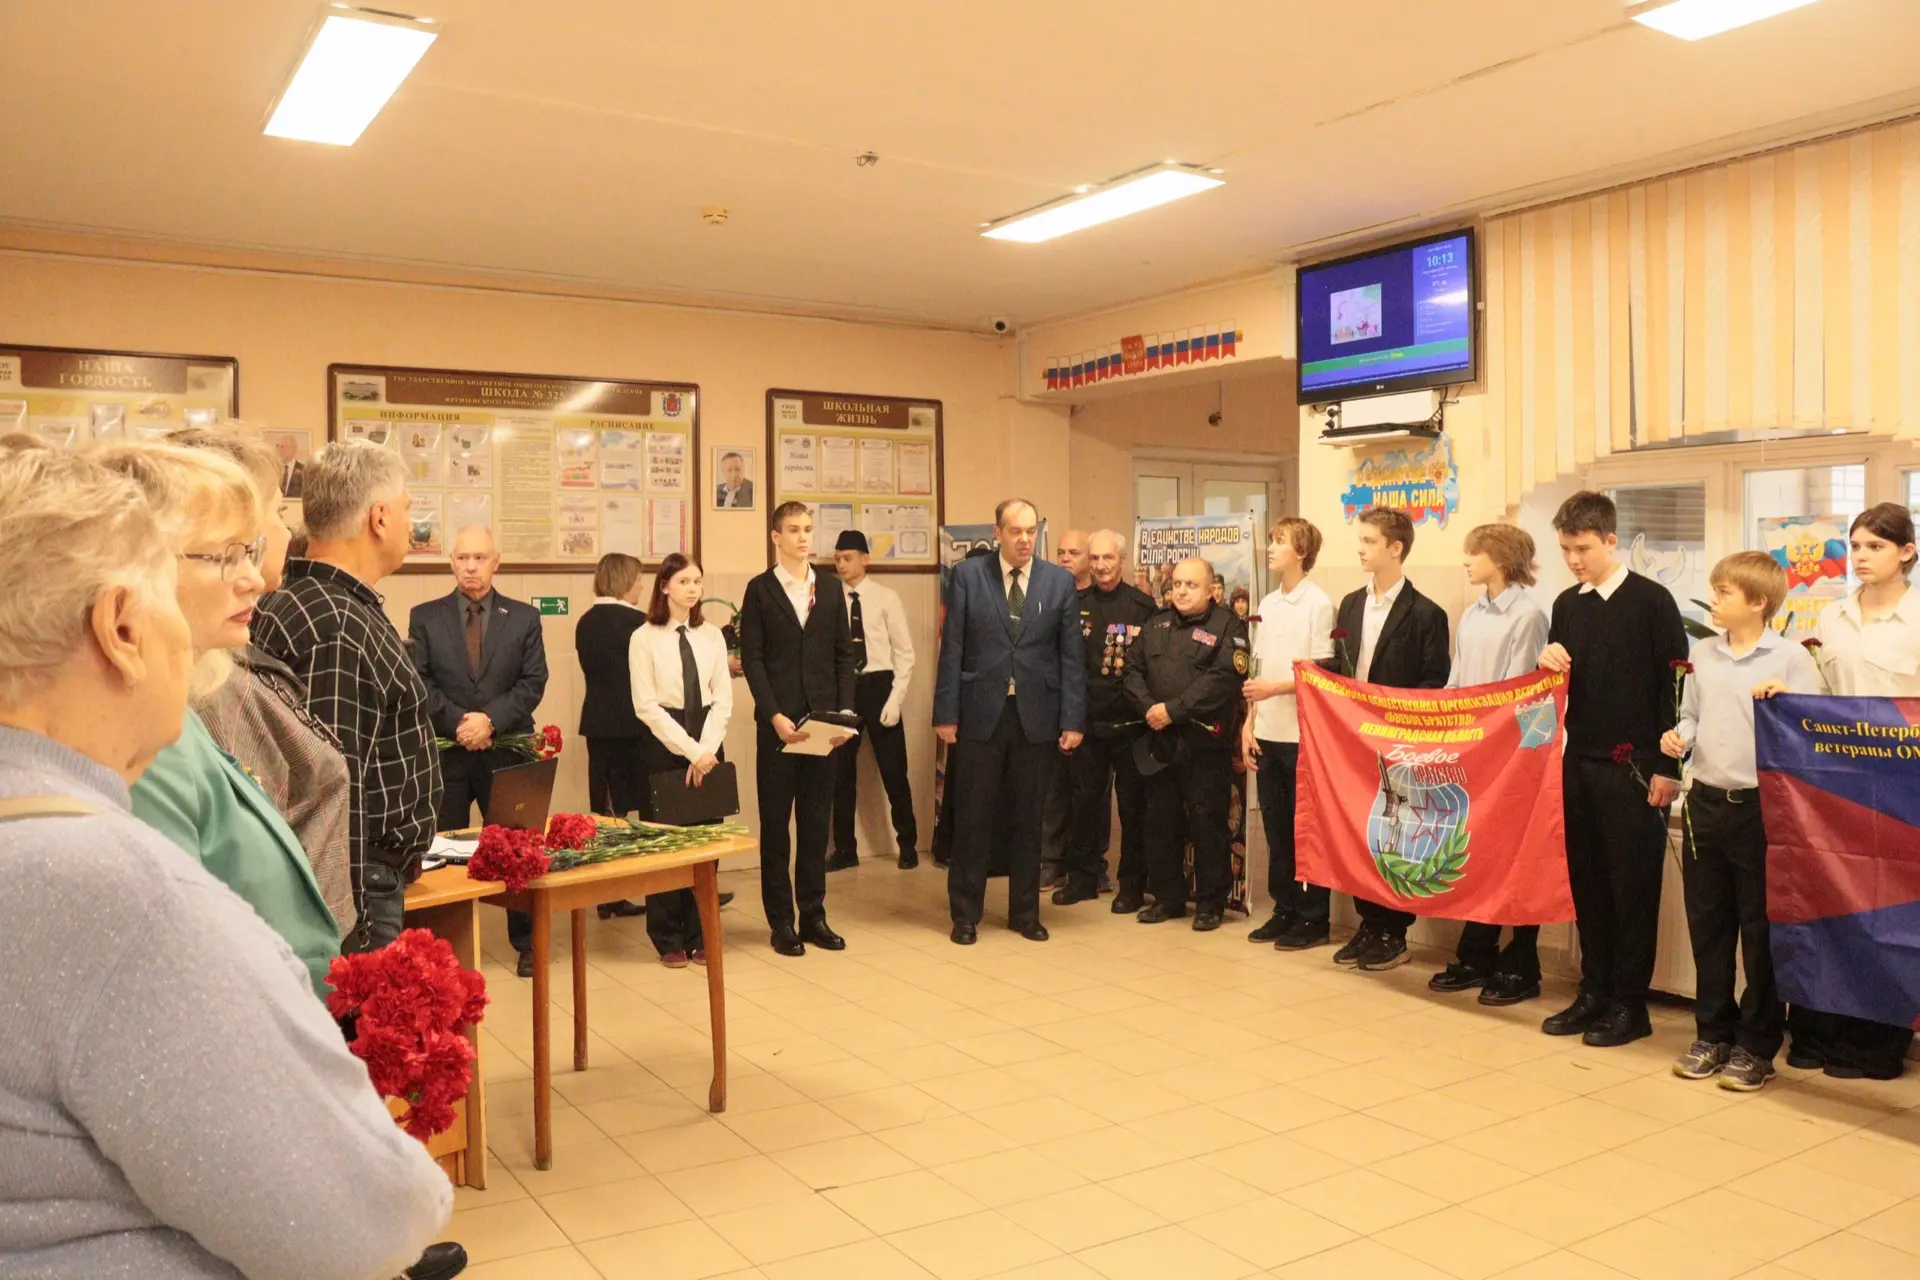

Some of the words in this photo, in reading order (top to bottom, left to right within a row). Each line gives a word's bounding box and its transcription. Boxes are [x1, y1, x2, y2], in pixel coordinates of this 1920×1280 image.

[1427, 252, 1454, 267] 10:13
[78, 359, 134, 373] НАША
[59, 373, 152, 388] ГОРДОСТЬ
[480, 386, 528, 398] ШКОЛА
[532, 391, 544, 400] №
[547, 391, 565, 400] 325
[823, 401, 890, 414] ШКОЛЬНАЯ
[380, 411, 460, 421] ИНФОРМАЦИЯ
[836, 413, 877, 425] ЖИЗНЬ
[590, 419, 655, 430] РАСПИСАНИЕ
[1373, 489, 1408, 508] НАША
[1411, 488, 1444, 508] СИЛА
[1141, 530, 1148, 545] В
[1151, 529, 1195, 545] ЕДИНСТВЕ
[1198, 527, 1239, 545] НАРОДОВ
[1141, 548, 1163, 564] СИЛА
[1440, 690, 1514, 712] ОРГАНИЗАЦИЯ
[1358, 722, 1444, 743] ЛЕНИНГРАДСКАЯ
[1444, 727, 1484, 743] ОБЛАСТЬ
[1802, 718, 1920, 742] Санкт-Петерб
[1385, 743, 1459, 763] Боевое
[1814, 742, 1892, 758] ветераны
